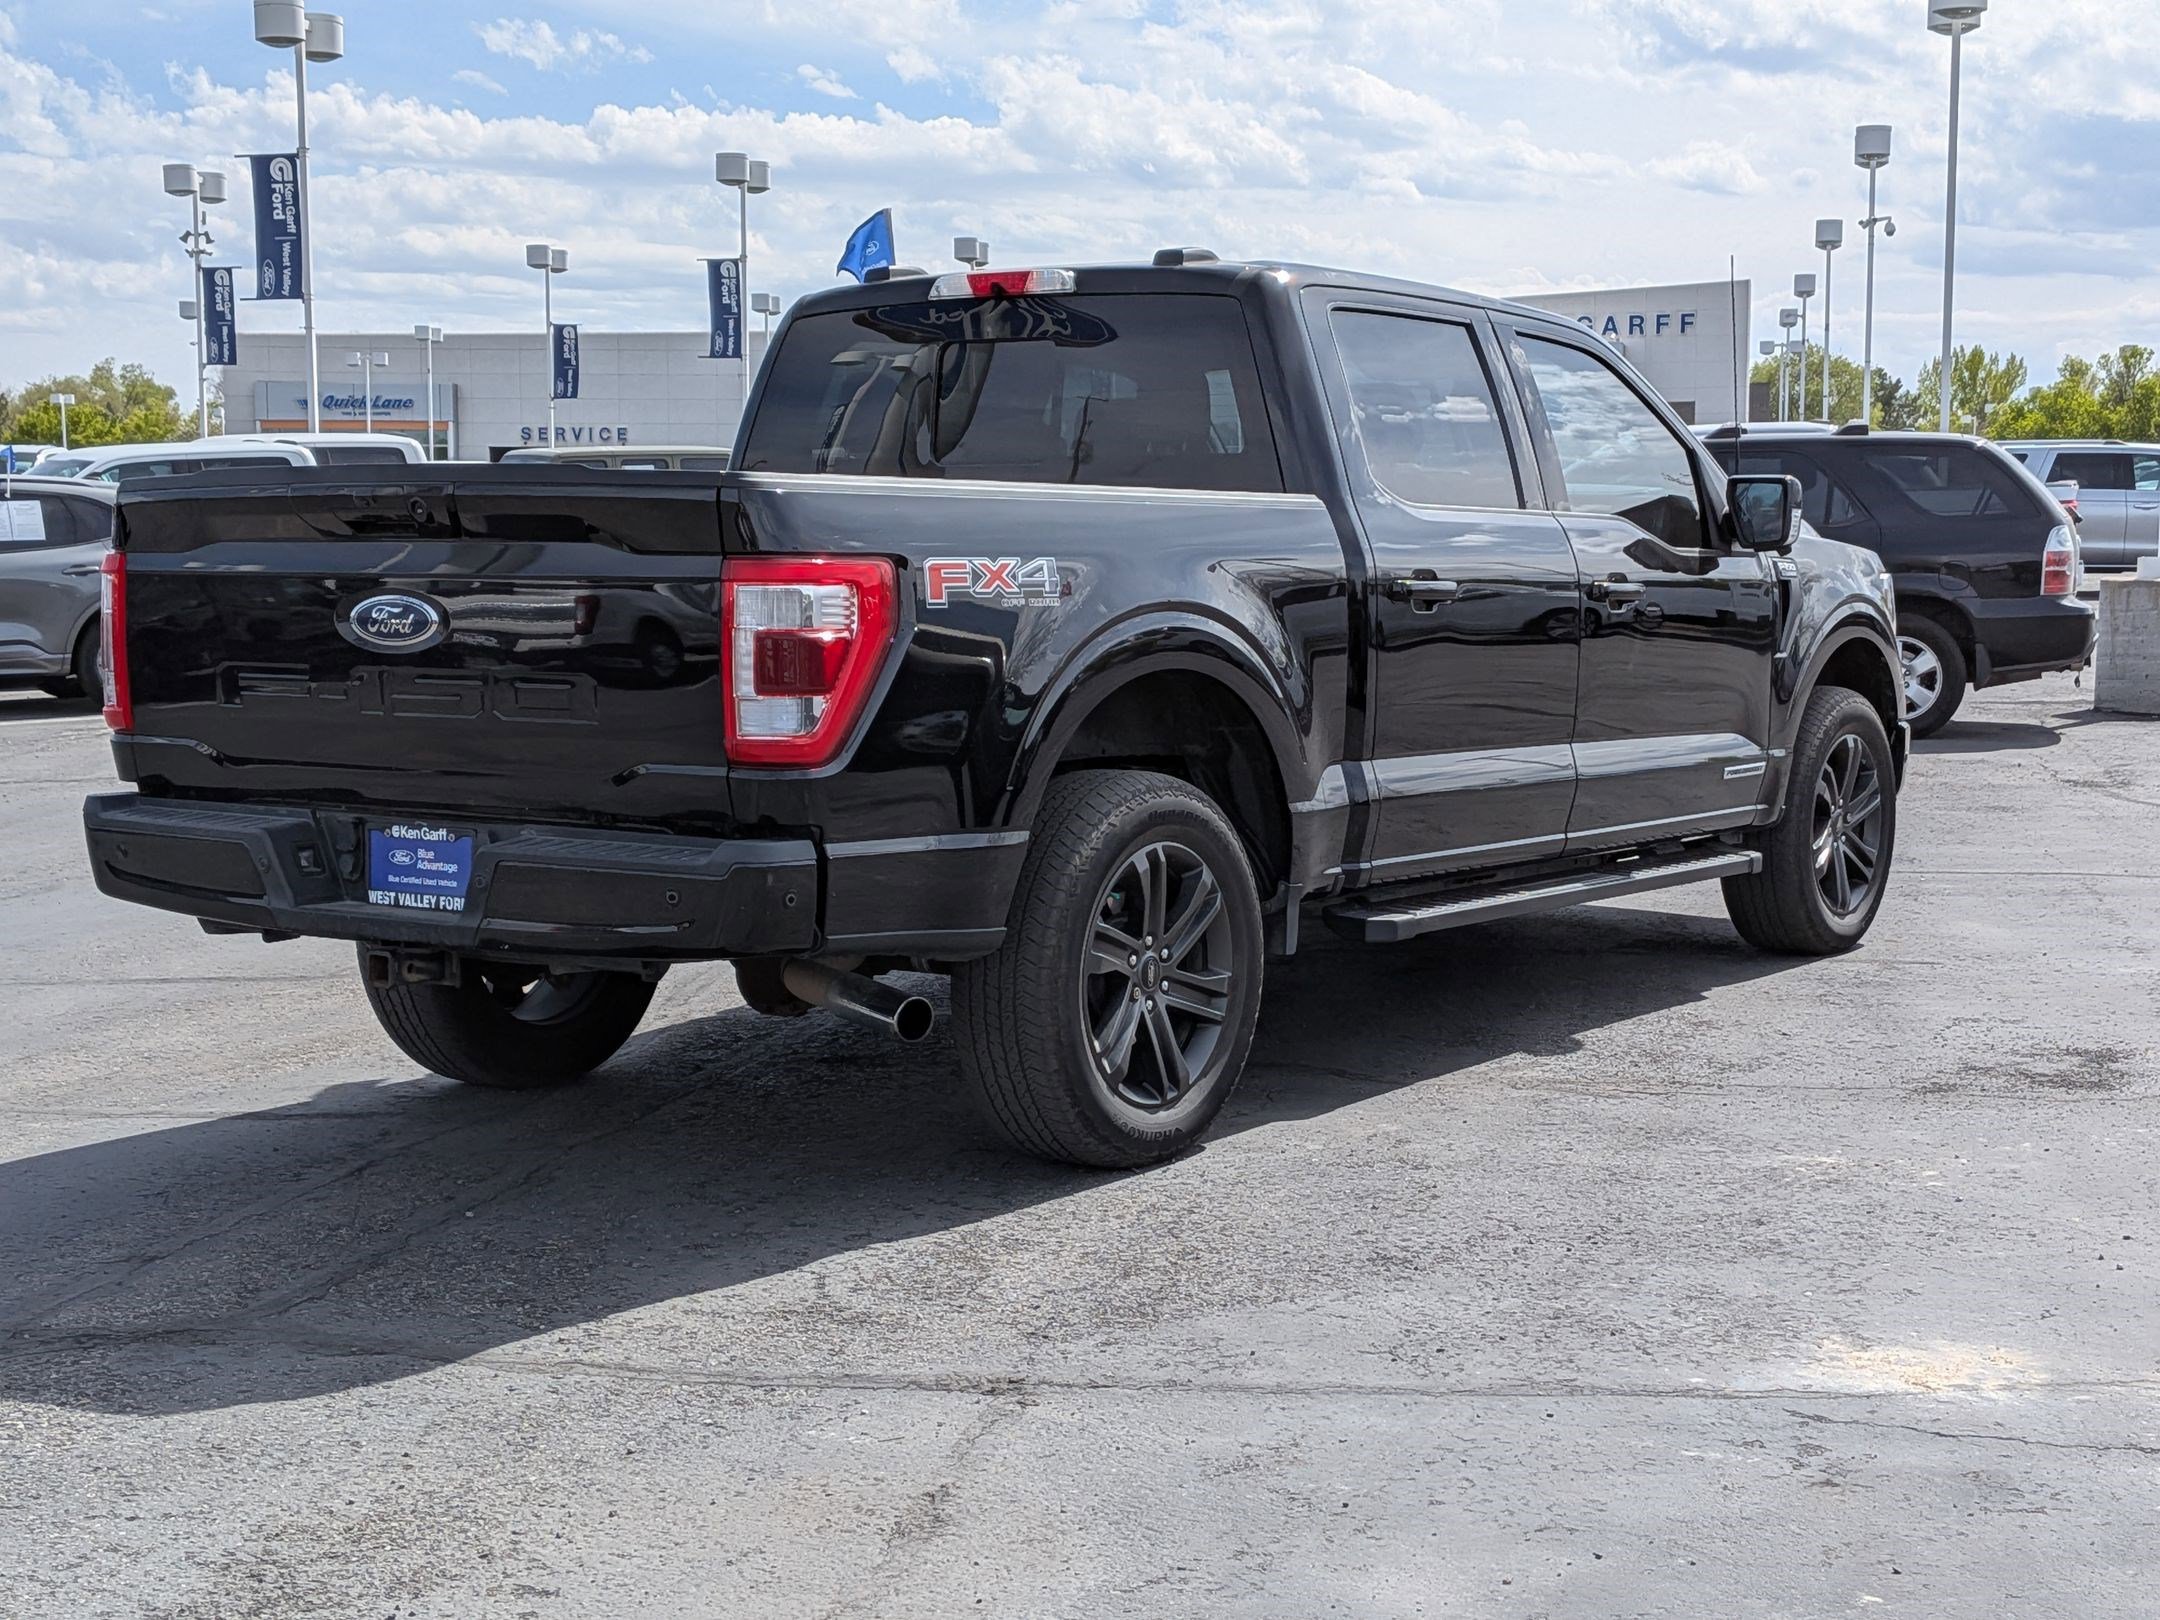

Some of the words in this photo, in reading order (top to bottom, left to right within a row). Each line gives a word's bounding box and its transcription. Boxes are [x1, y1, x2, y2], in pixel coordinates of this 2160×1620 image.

[271, 183, 285, 220] Ford
[284, 183, 295, 205] Ken
[285, 205, 297, 233] Garff
[282, 241, 291, 266] West
[281, 267, 292, 296] Valley
[721, 278, 730, 304] Ford
[214, 286, 224, 311] Ford
[321, 395, 368, 411] Quick
[371, 395, 415, 409] Lane
[520, 426, 628, 442] SERVICE
[923, 557, 1060, 608] FX4
[368, 605, 415, 634] Ford
[217, 661, 598, 724] F-150
[400, 825, 420, 839] Ken
[421, 827, 447, 841] Garff
[416, 859, 458, 874] Advantage
[417, 848, 435, 860] Blue
[368, 890, 396, 906] WEST
[398, 892, 437, 909] VALLEY
